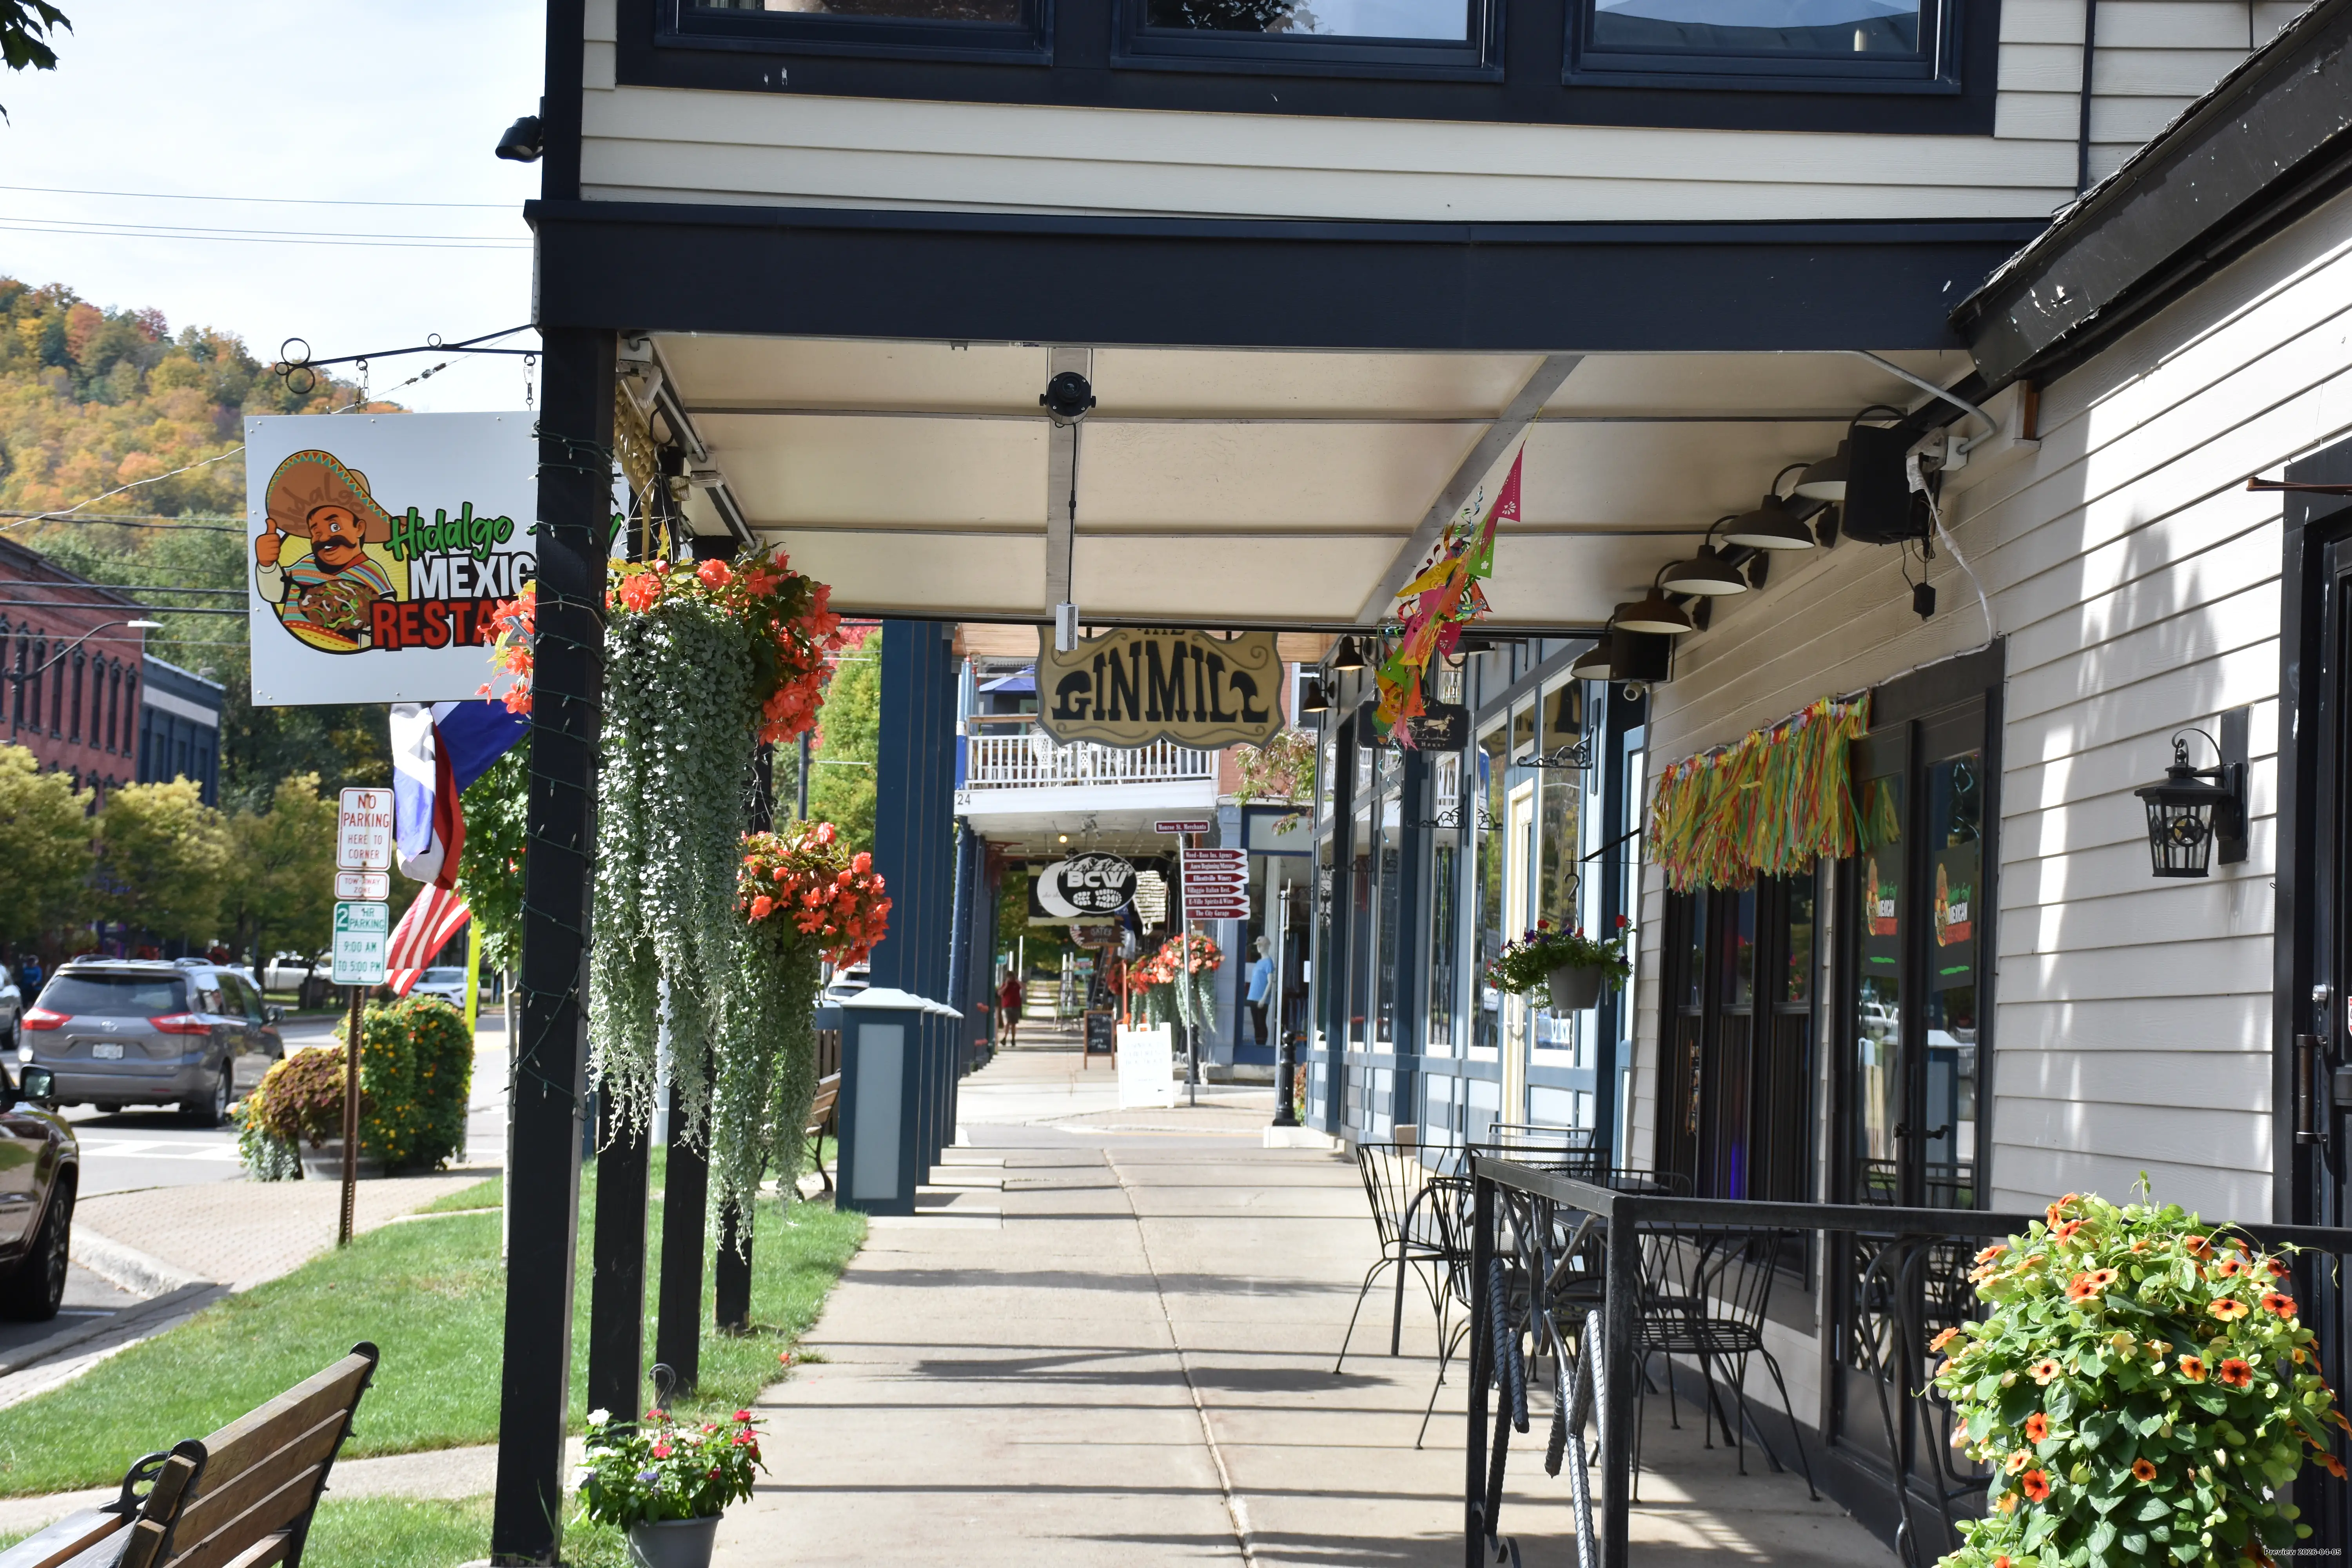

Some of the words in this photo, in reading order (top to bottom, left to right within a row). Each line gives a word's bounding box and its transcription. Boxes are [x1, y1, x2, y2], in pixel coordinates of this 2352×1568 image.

[385, 502, 514, 560] Hidalgo
[409, 552, 536, 599] MEXIC
[1051, 640, 1269, 723] GINMILL
[358, 795, 376, 809] NO
[958, 794, 971, 805] 24
[344, 812, 389, 828] PARKING
[348, 834, 367, 844] HERE
[374, 834, 382, 844] TO
[348, 849, 379, 859] CORNER
[1067, 871, 1127, 887] BCW
[338, 908, 348, 927] 2
[363, 908, 374, 917] HR
[1948, 901, 1968, 924] MEXICAN
[350, 918, 385, 929] PARKING
[344, 941, 361, 952] 9:00
[365, 941, 376, 952] AM
[338, 960, 347, 971] TO
[350, 960, 367, 972] 5:00
[370, 961, 381, 972] PM
